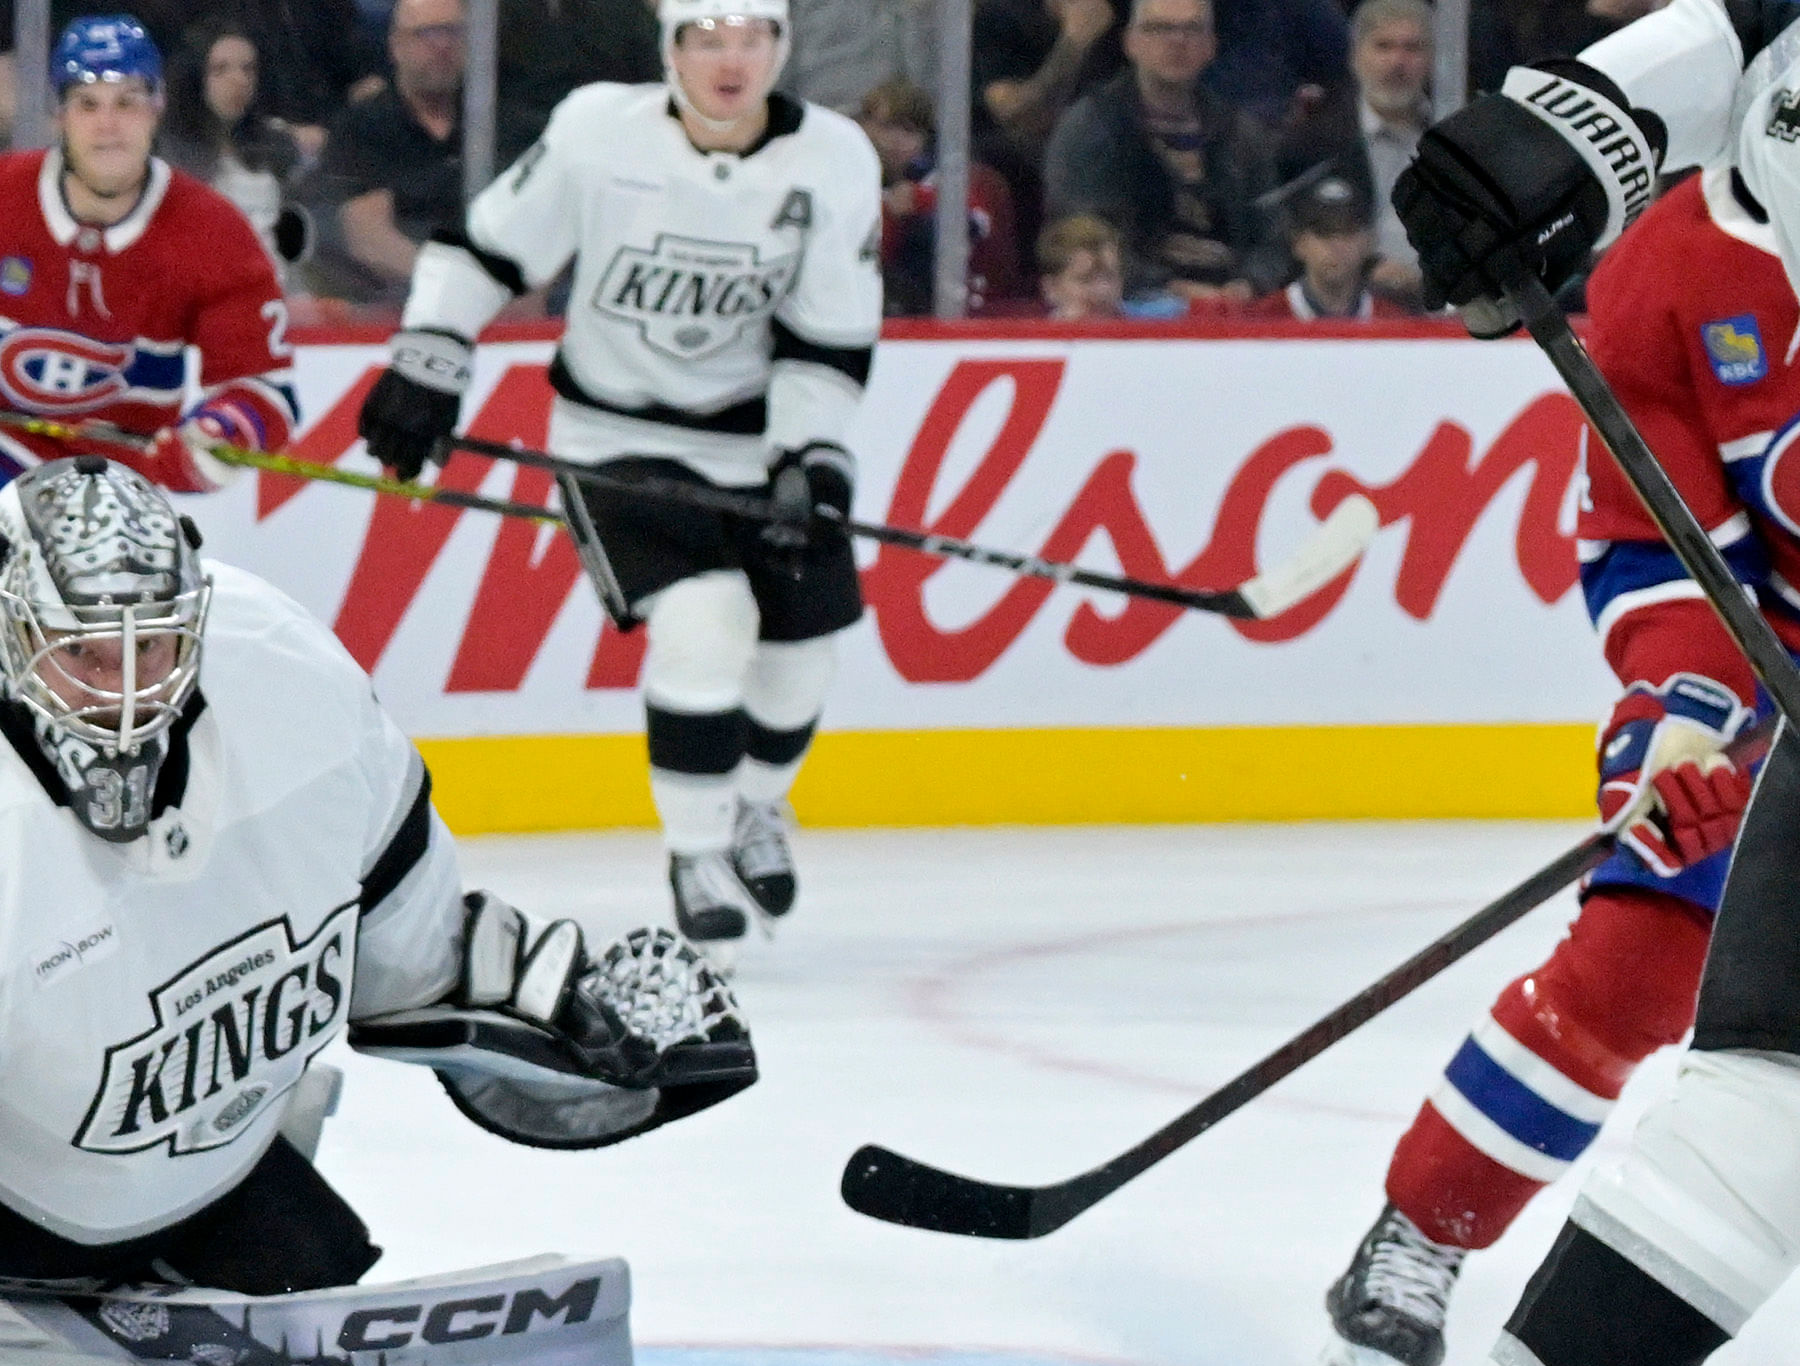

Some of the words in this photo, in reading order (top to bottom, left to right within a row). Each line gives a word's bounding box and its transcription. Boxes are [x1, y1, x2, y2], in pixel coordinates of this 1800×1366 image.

[770, 187, 812, 230] A
[615, 261, 785, 316] KINGS
[174, 986, 202, 1017] Los
[204, 948, 277, 996] Angeles
[109, 931, 342, 1138] KINGS
[336, 1278, 602, 1353] CCM
